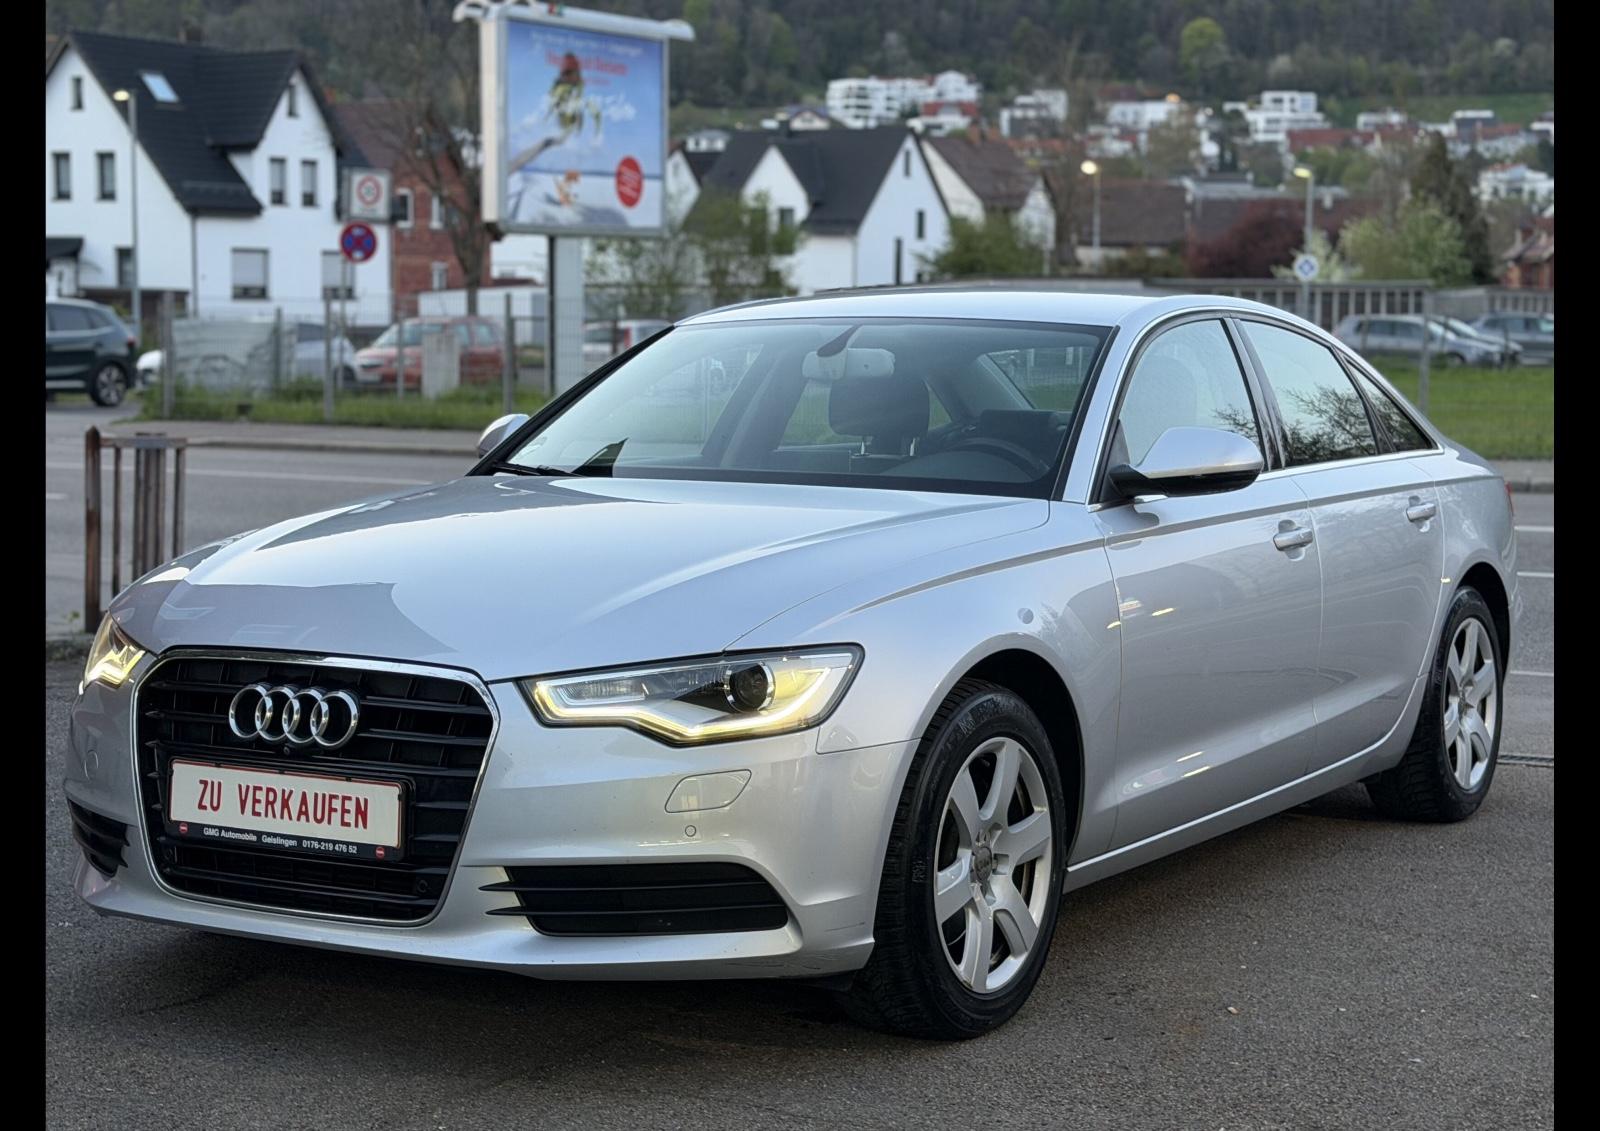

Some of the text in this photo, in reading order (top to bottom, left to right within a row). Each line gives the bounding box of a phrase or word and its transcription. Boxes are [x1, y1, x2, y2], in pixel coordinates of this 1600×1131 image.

[197, 779, 369, 830] ZU VERKAUFEN
[203, 827, 358, 854] GMG Automobile Geislingen 0176-219 476 52
